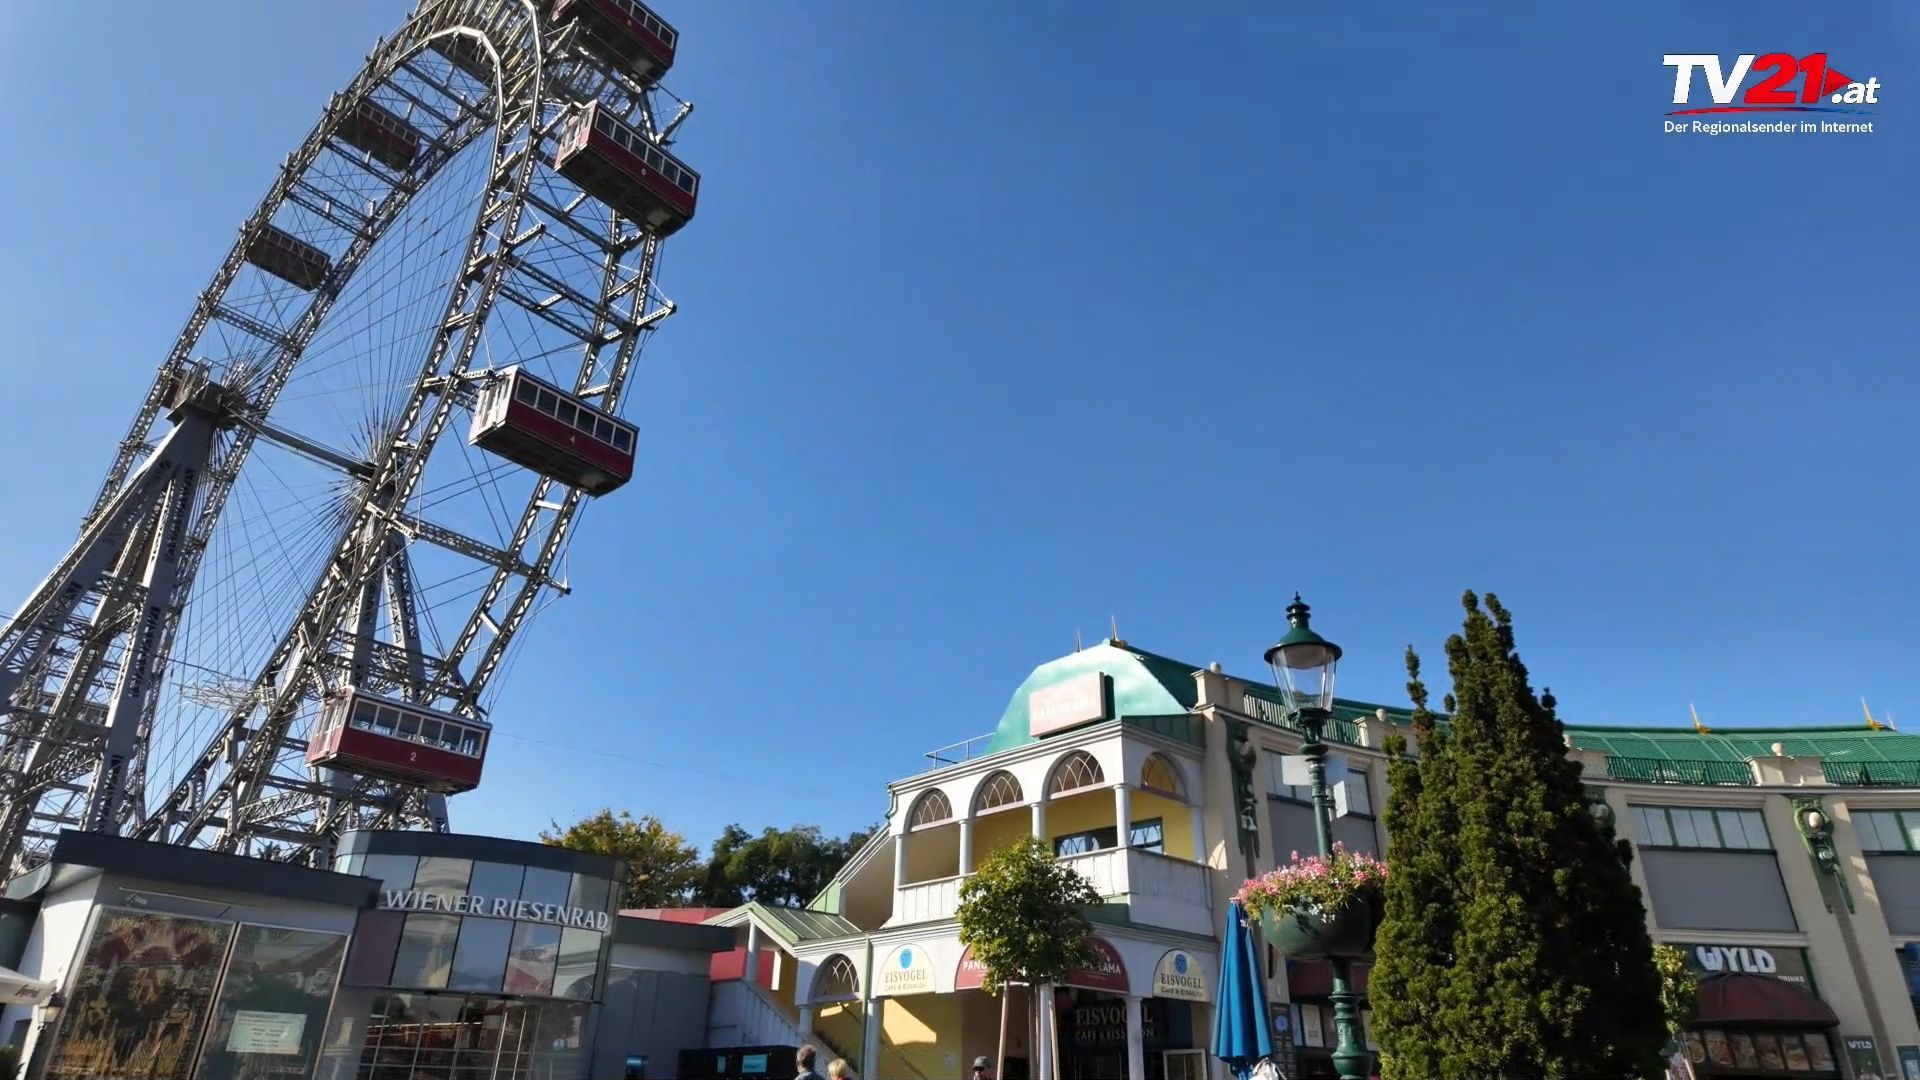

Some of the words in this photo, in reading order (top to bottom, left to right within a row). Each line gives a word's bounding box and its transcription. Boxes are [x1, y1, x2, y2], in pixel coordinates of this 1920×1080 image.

[570, 435, 576, 444] 4
[410, 752, 417, 761] 2
[385, 889, 484, 915] WIENER
[491, 897, 609, 930] RIESENRAD
[1696, 946, 1776, 974] WYLD
[885, 968, 927, 984] EISVOGEL
[1161, 973, 1202, 988] EISVOGEL
[1847, 1040, 1873, 1049] WYLD
